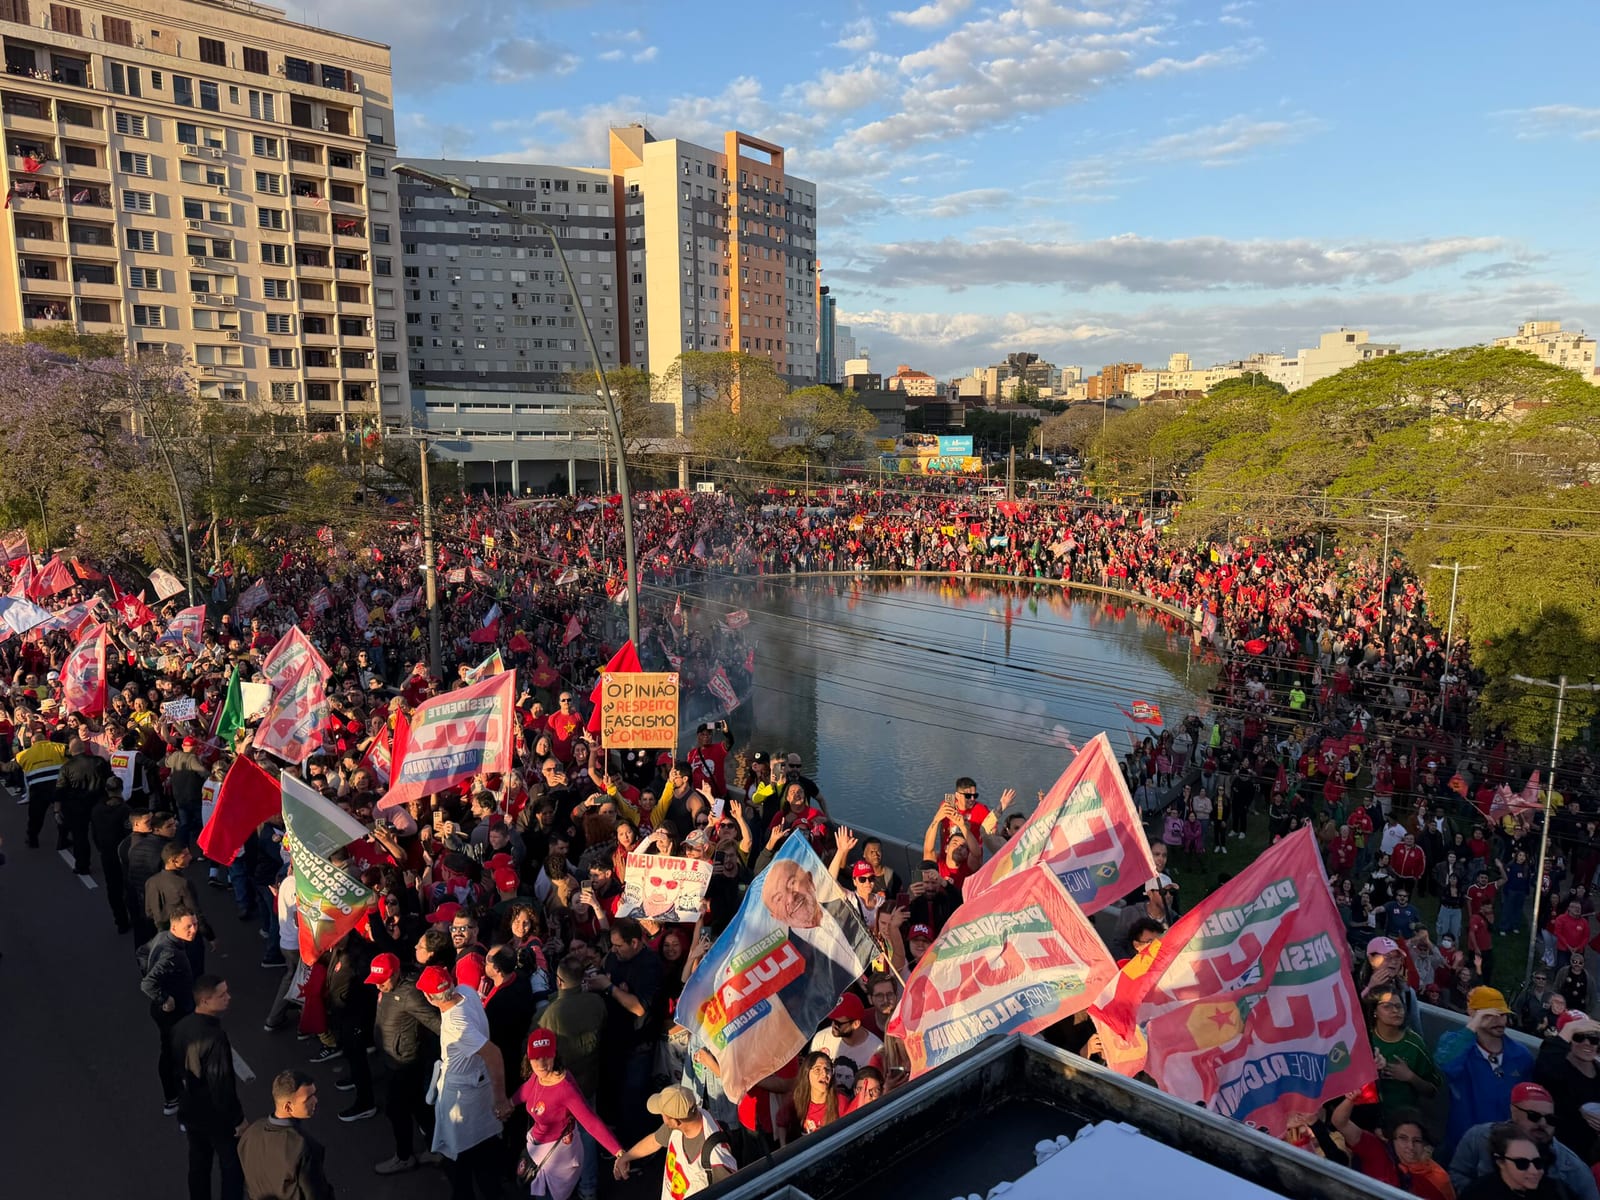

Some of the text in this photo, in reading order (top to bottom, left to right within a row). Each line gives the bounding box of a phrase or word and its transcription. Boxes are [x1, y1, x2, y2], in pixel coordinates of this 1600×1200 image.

[607, 682, 677, 698] OPINIÃO
[602, 700, 675, 713] EU RESPEITO
[605, 714, 676, 728] FASCISMO
[604, 727, 673, 743] EU COMBATO
[627, 854, 654, 869] MEU
[659, 857, 687, 871] VOTO
[299, 851, 347, 897] DUVIDOSO
[333, 871, 366, 897] CERTO
[310, 876, 325, 891] DE
[322, 889, 352, 915] NOVO
